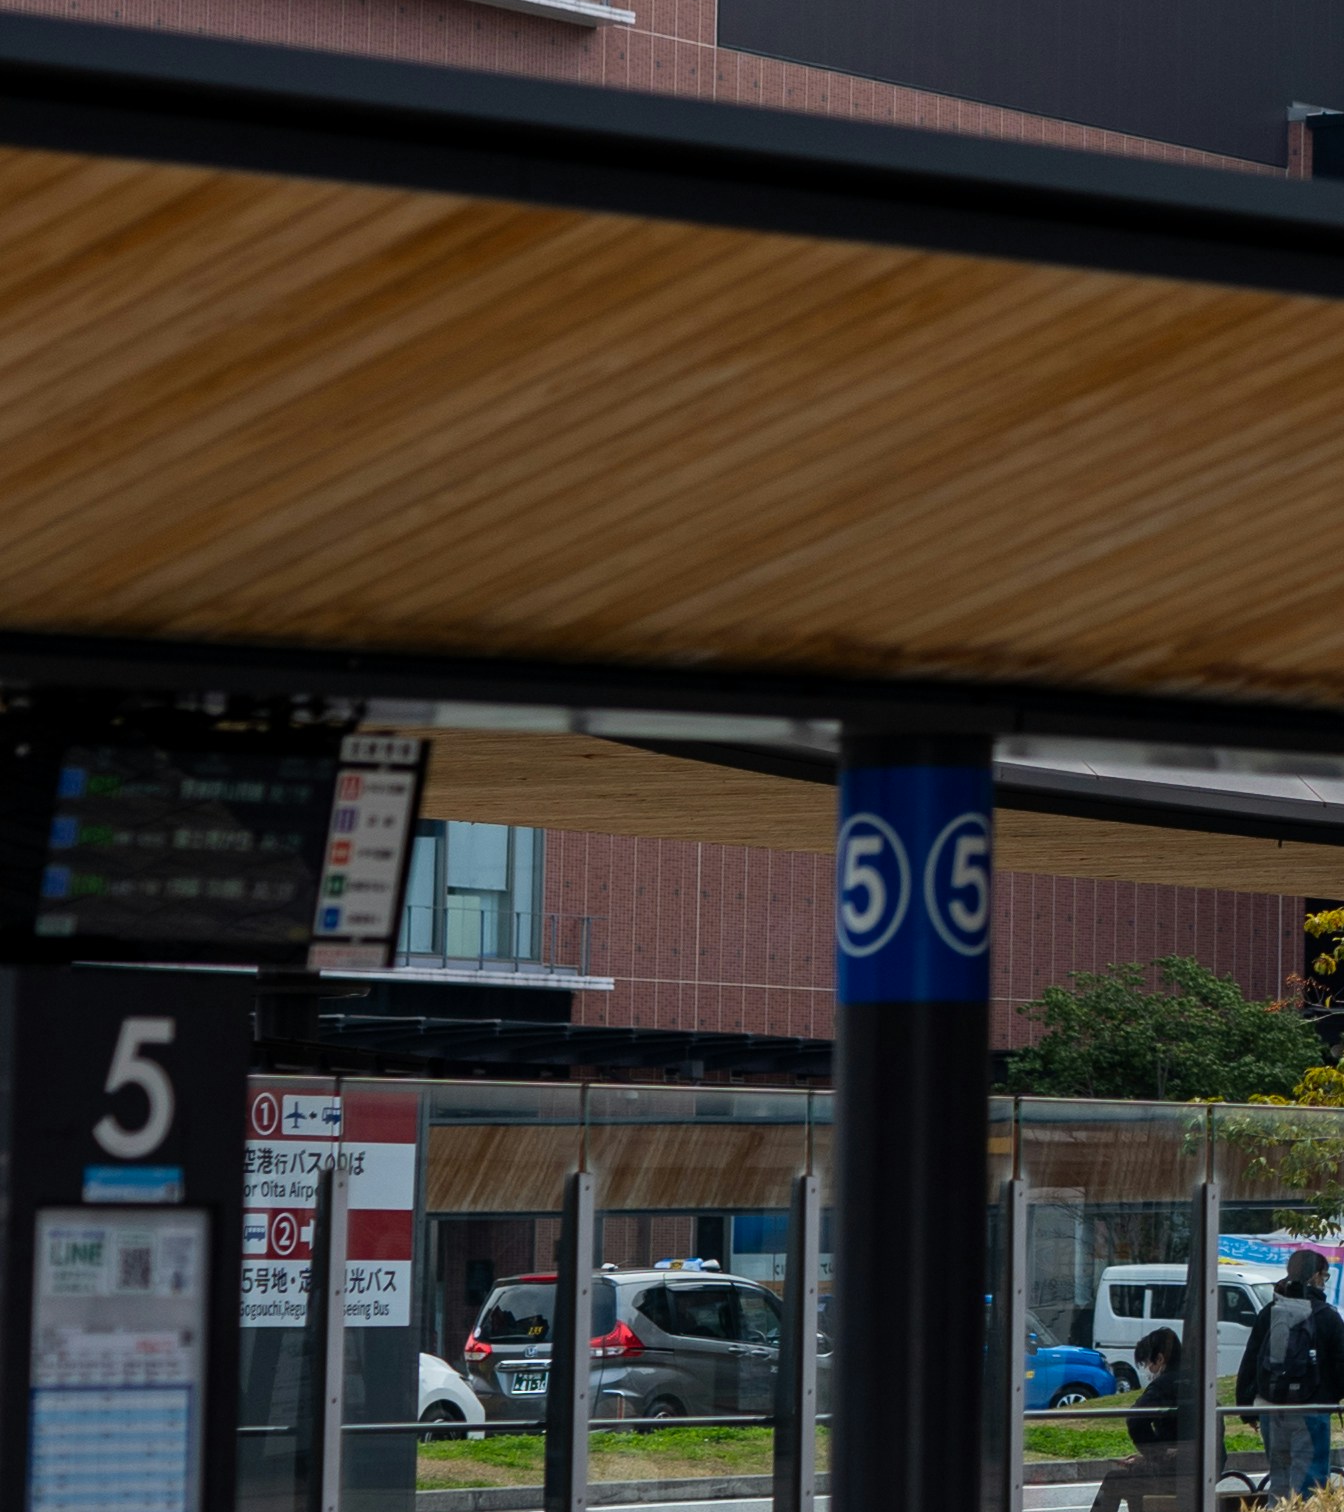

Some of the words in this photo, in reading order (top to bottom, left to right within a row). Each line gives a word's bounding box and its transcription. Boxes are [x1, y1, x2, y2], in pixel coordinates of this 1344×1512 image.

[843, 837, 885, 933] 5
[949, 837, 989, 933] 5
[91, 1016, 176, 1160] 5
[261, 1181, 286, 1198] Oita
[289, 1181, 318, 1201] Airp
[50, 1241, 104, 1267] LINE
[373, 1303, 390, 1317] Bus
